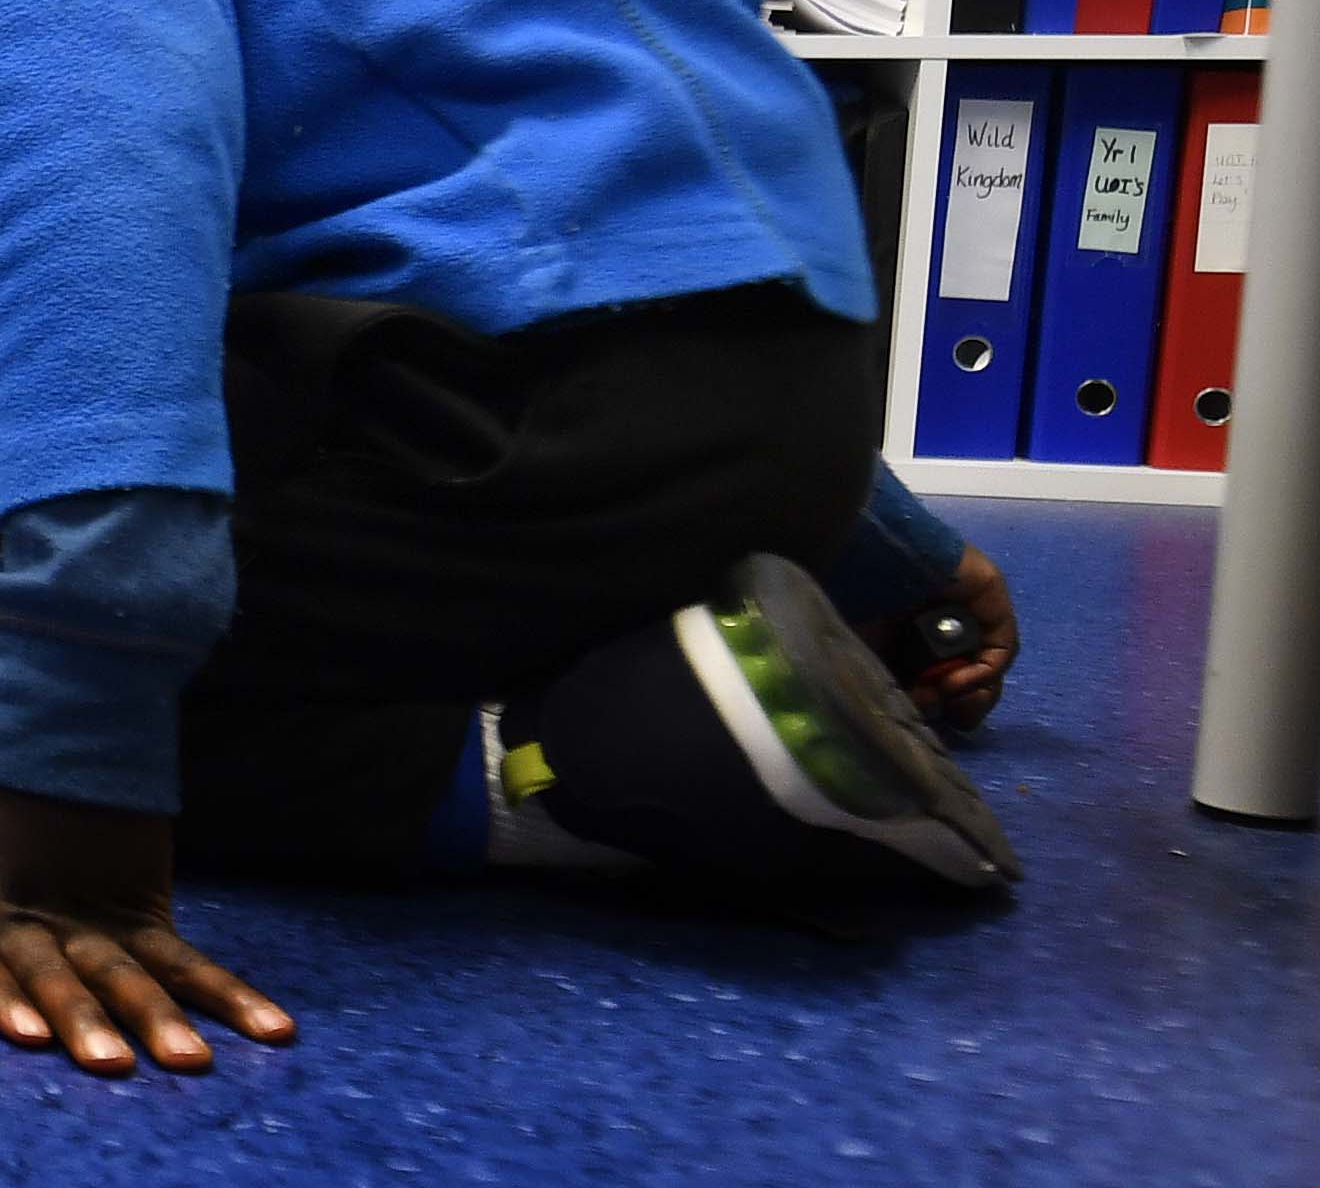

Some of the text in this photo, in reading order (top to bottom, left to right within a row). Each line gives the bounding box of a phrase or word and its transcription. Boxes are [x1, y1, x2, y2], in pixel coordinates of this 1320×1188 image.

[967, 121, 1015, 150] Wild
[1101, 139, 1123, 164] Yr
[956, 165, 1023, 199] Kingdom
[1085, 207, 1130, 231] Family
